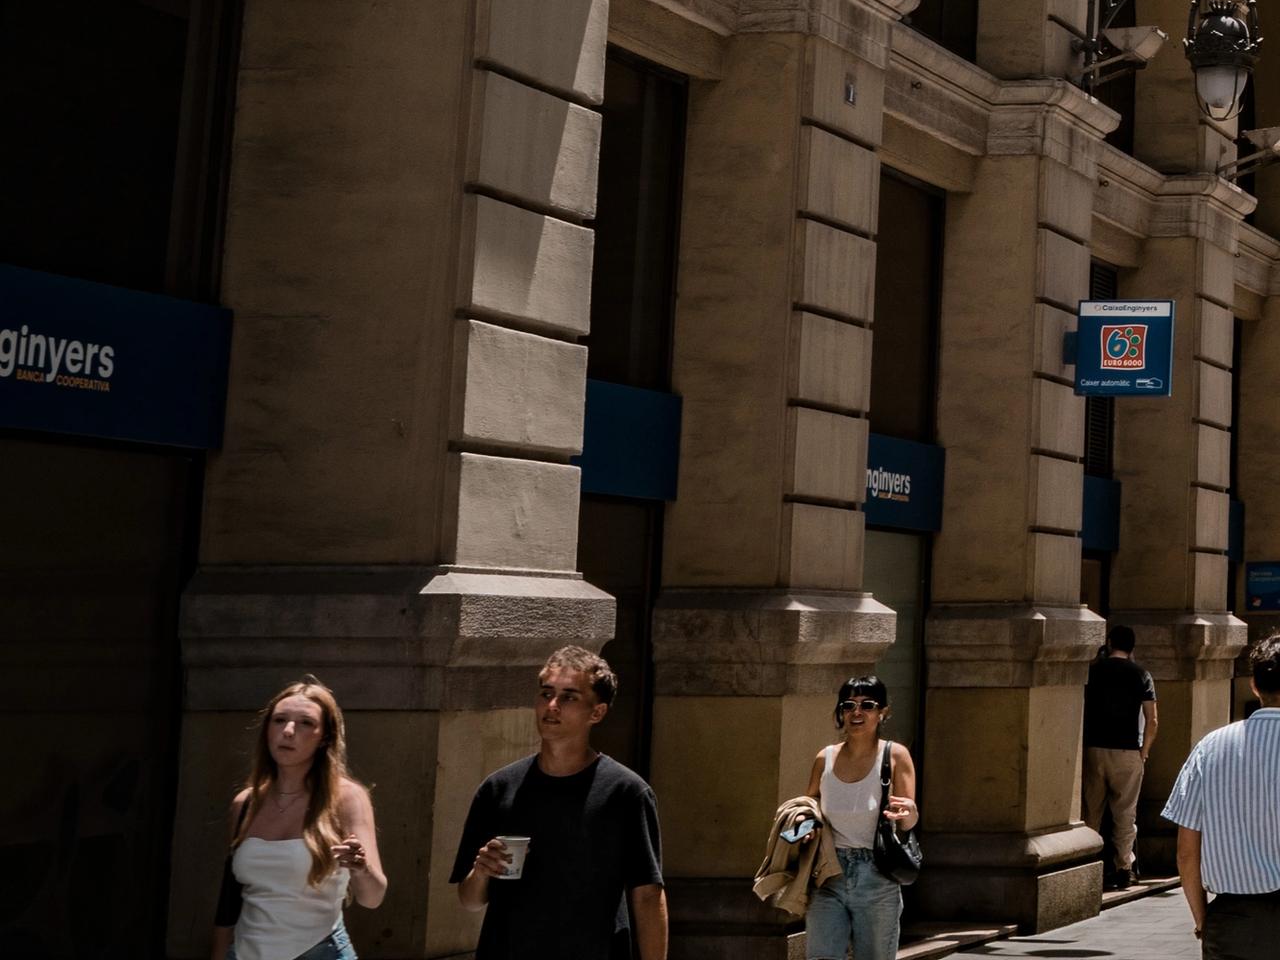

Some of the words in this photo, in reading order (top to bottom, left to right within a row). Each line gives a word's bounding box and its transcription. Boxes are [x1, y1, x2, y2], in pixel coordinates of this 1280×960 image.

[1103, 304, 1157, 312] CaixaEnginyers
[1123, 359, 1142, 367] 6000
[16, 368, 45, 383] BANCA
[56, 375, 111, 392] COOPERATIVA
